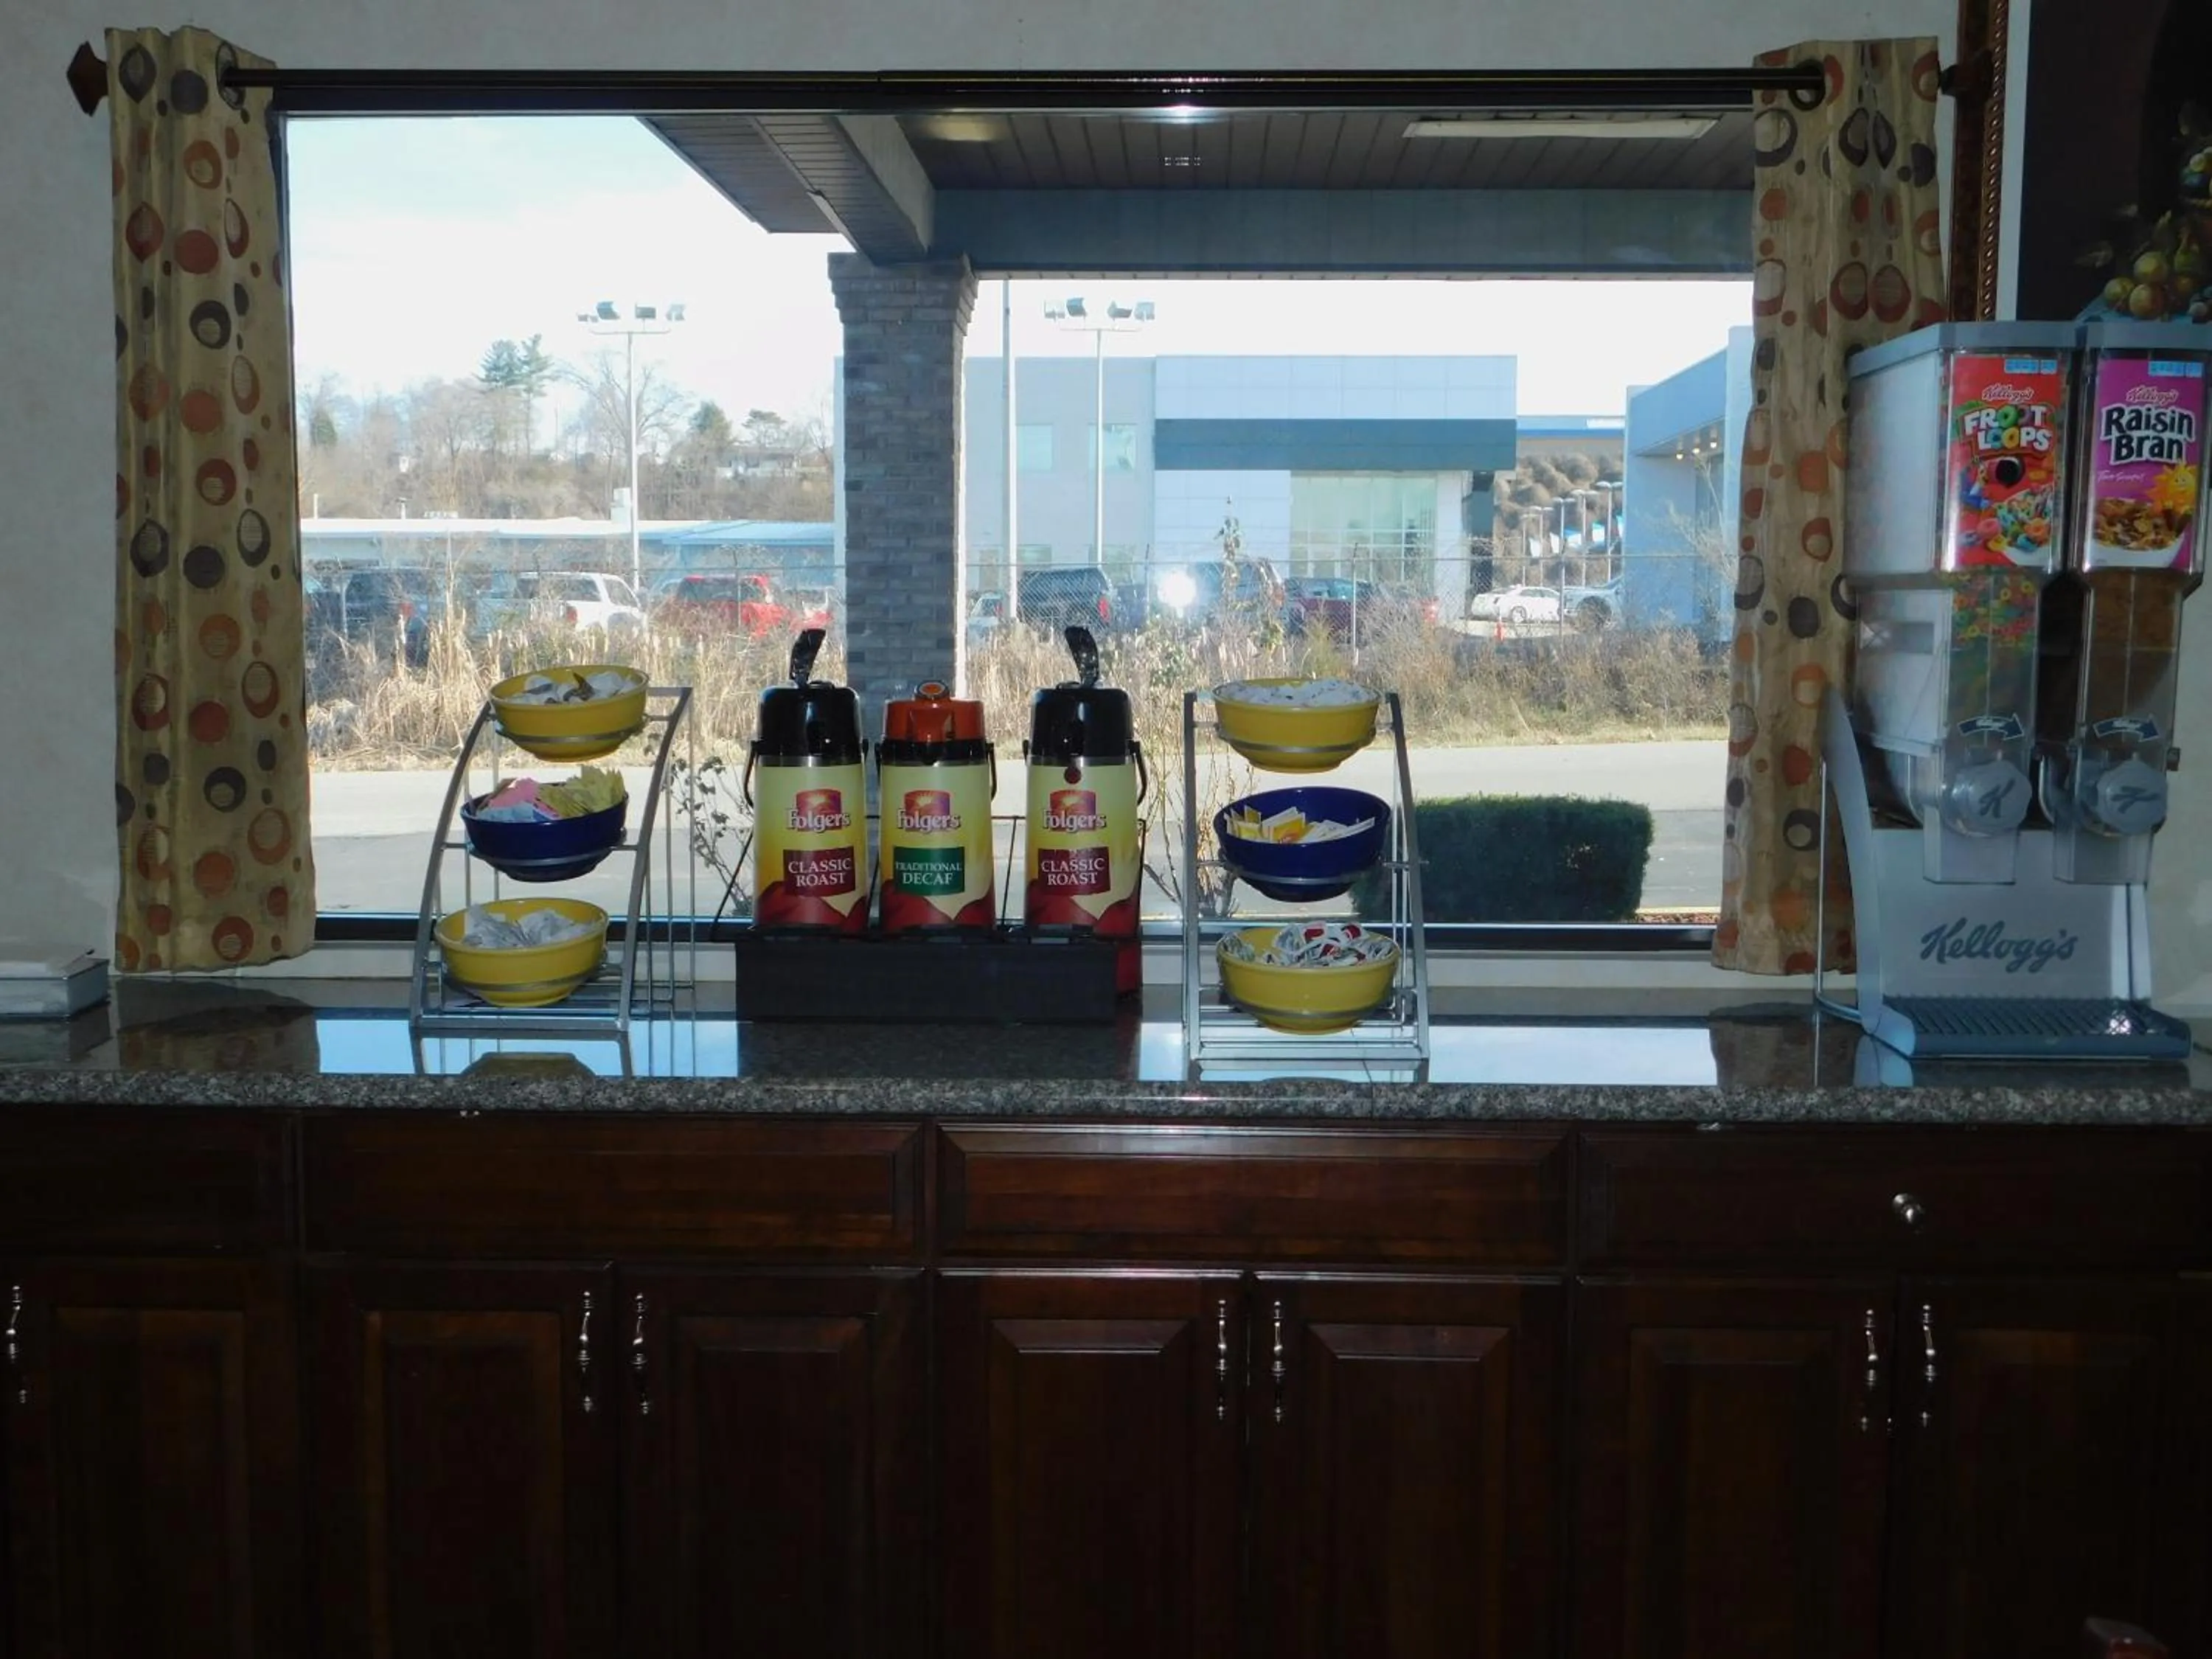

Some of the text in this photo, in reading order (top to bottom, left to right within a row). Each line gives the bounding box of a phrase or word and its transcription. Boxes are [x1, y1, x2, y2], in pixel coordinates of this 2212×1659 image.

[2103, 406, 2194, 439] Raisin
[1978, 425, 2052, 451] LOOPS
[2113, 434, 2184, 462] Bran
[788, 809, 851, 833] Folgers
[897, 809, 961, 833] Folgers
[1043, 809, 1107, 833] Folgers
[787, 858, 852, 874] CLASSIC
[895, 861, 962, 872] TRADITIONAL
[1040, 858, 1105, 873] CLASSIC
[796, 872, 846, 887] ROAST
[902, 872, 953, 886] DECAF
[1047, 872, 1098, 886] ROAST
[1920, 917, 2079, 973] Kellogg's
